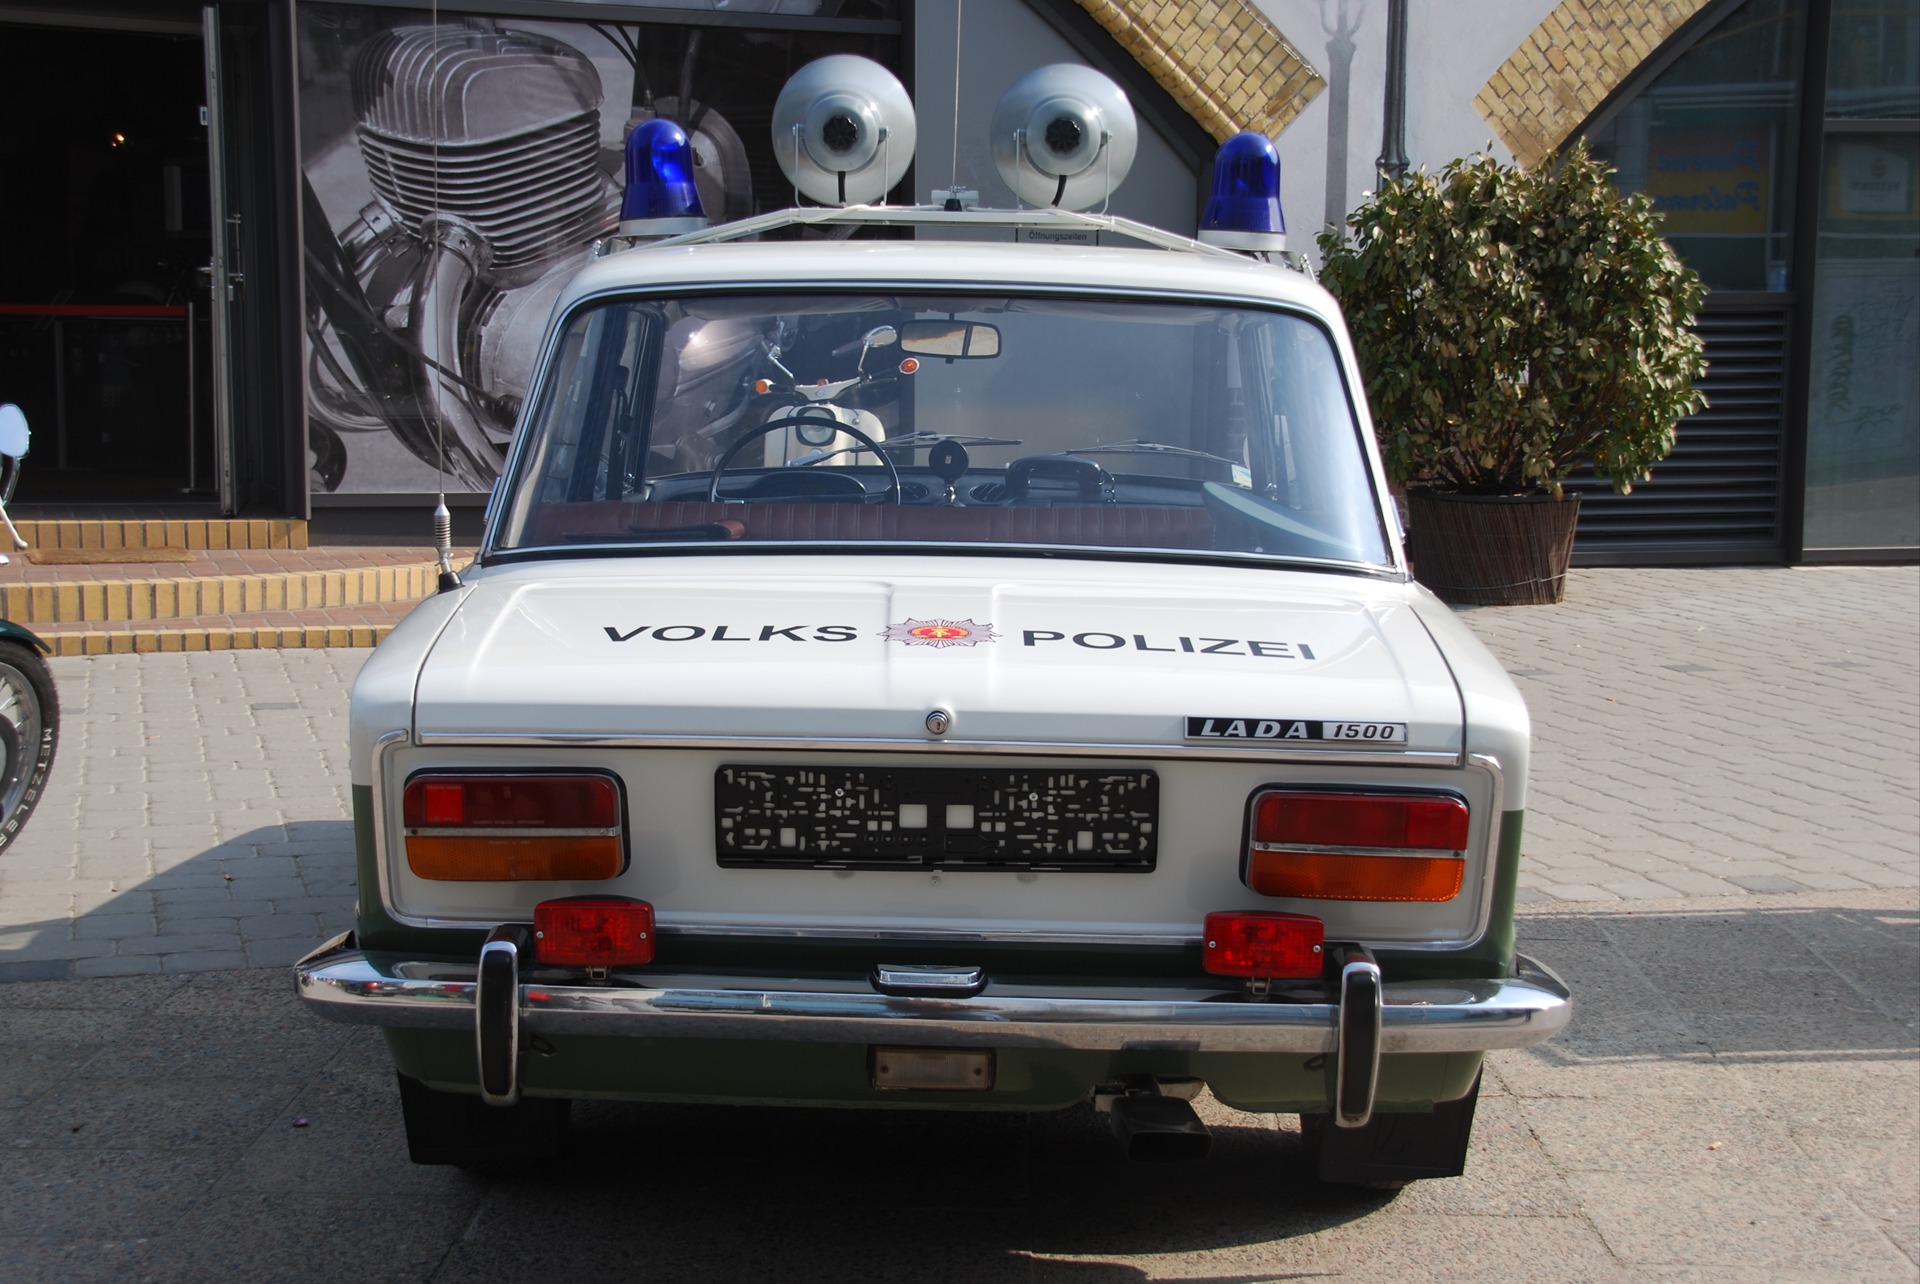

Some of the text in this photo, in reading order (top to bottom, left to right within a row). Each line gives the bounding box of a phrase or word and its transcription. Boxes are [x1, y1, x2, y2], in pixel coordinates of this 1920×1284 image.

[1028, 230, 1087, 242] Öffnungszeiten
[603, 625, 1316, 660] VOLKS POLIZEI
[1200, 719, 1395, 740] LADA 1500
